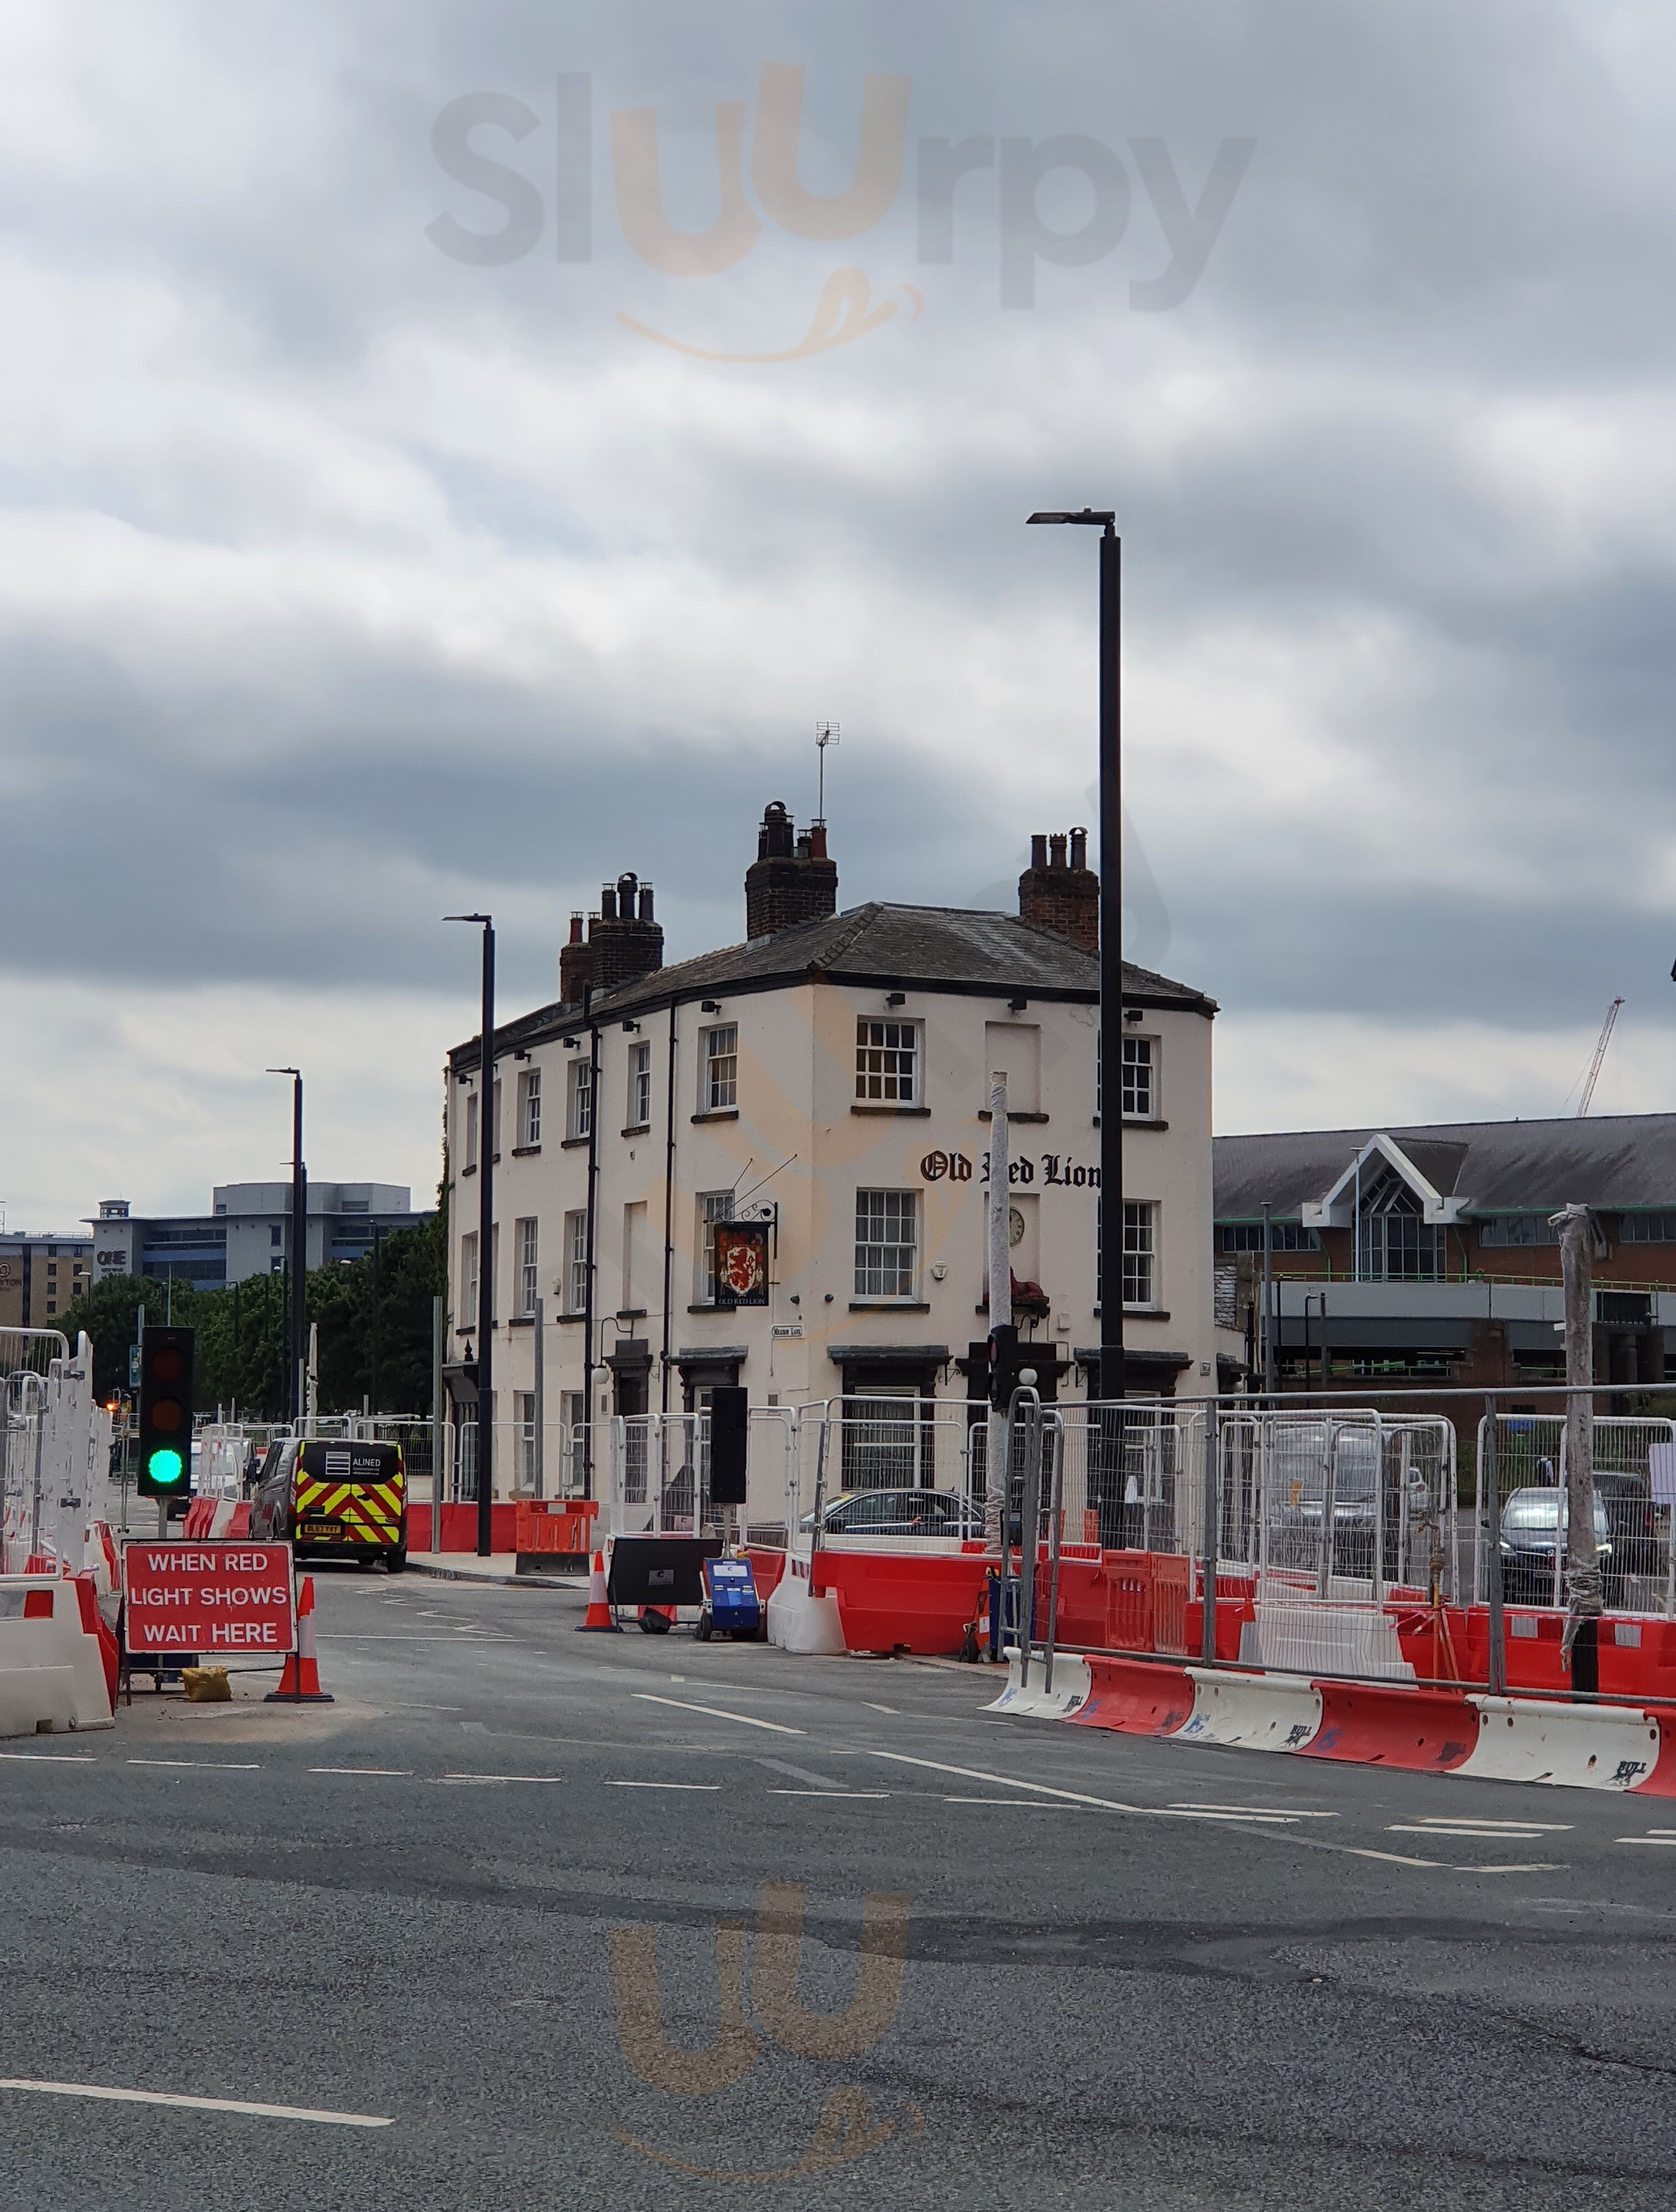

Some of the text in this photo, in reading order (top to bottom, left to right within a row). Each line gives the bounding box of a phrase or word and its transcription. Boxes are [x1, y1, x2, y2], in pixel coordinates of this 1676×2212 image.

[921, 1150, 972, 1181] Old
[1041, 1154, 1102, 1189] Lion
[97, 1251, 126, 1265] ONE
[352, 1458, 381, 1467] ALINED
[147, 1553, 268, 1572] WHEN RED
[131, 1586, 287, 1606] LIGHT SHOWS
[144, 1623, 277, 1643] WAIT HERE
